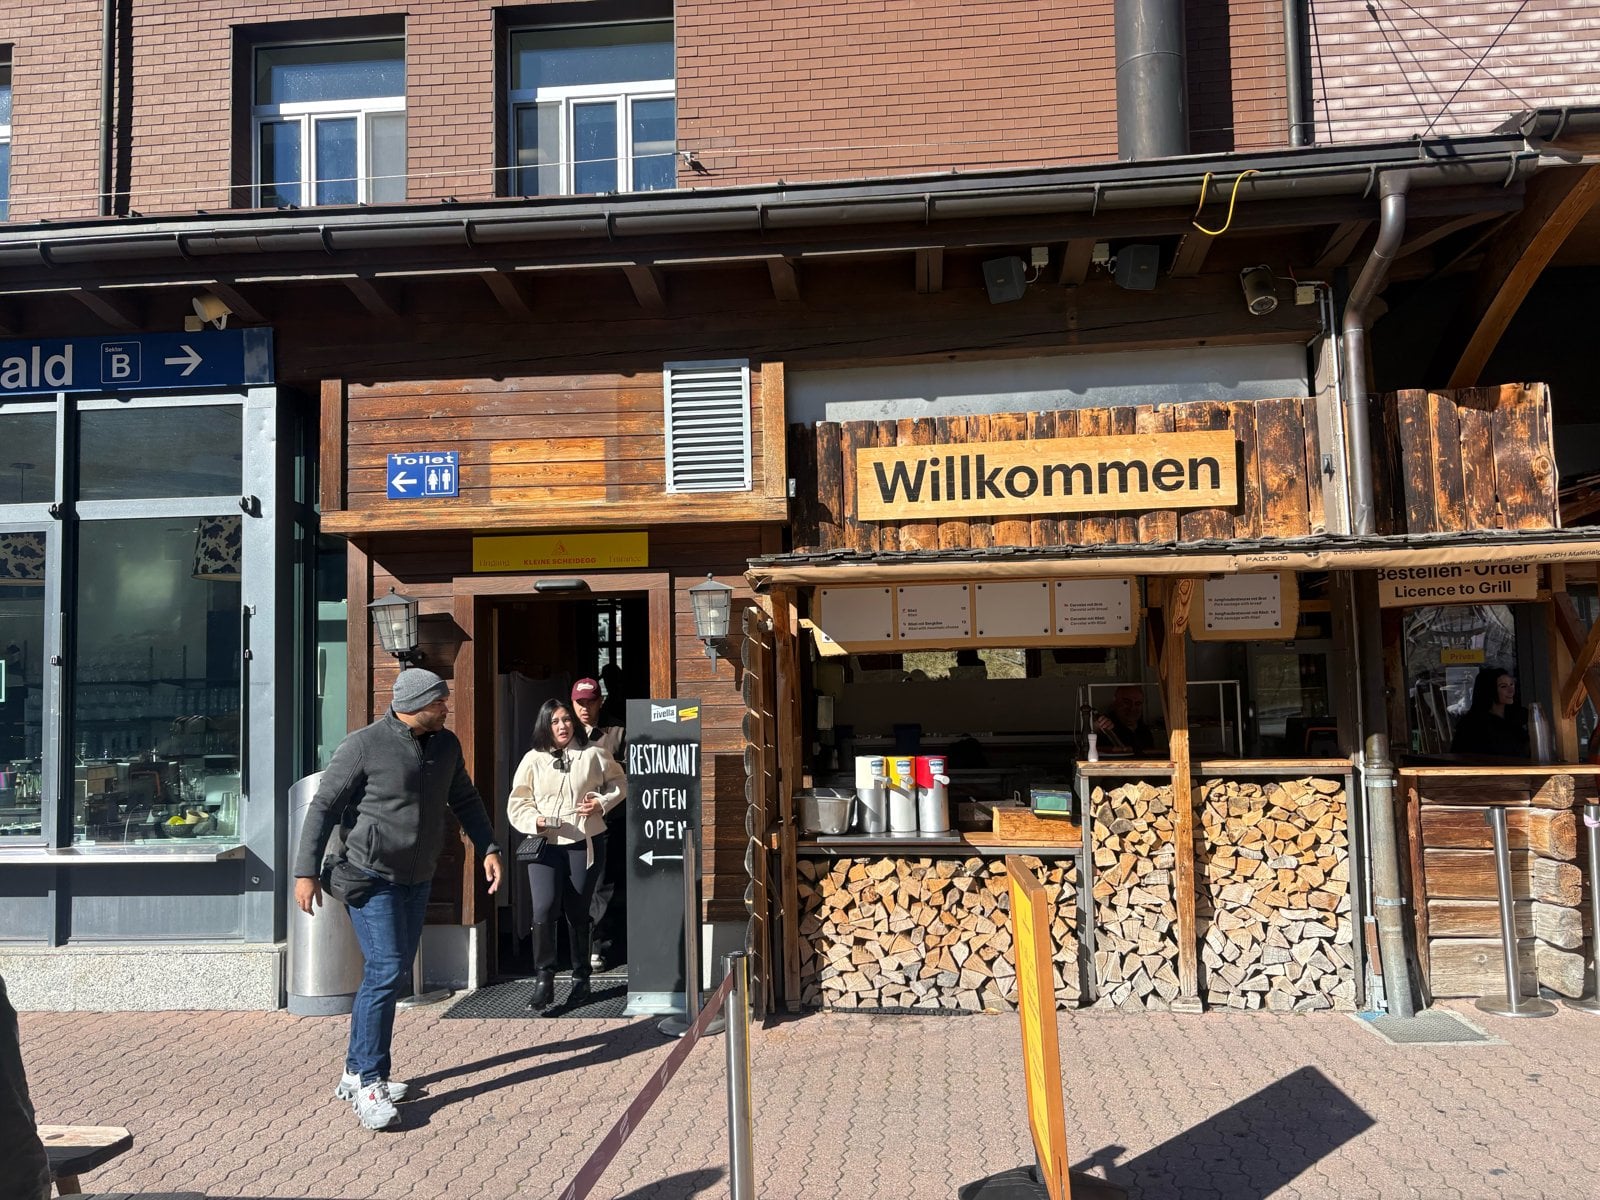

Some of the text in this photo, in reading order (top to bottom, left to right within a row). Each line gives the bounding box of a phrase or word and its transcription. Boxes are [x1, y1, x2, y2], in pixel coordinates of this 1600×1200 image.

[111, 353, 131, 379] B
[392, 454, 455, 466] Toilet
[873, 453, 1221, 504] Willkommen
[523, 557, 597, 566] KLEINE SCHEIDEGG
[1474, 564, 1530, 576] Order
[1395, 580, 1511, 598] Licence to Grill
[653, 708, 675, 719] rivella
[629, 743, 698, 777] RESTAURANT
[641, 787, 687, 810] OFFEN
[644, 819, 687, 840] OPEN
